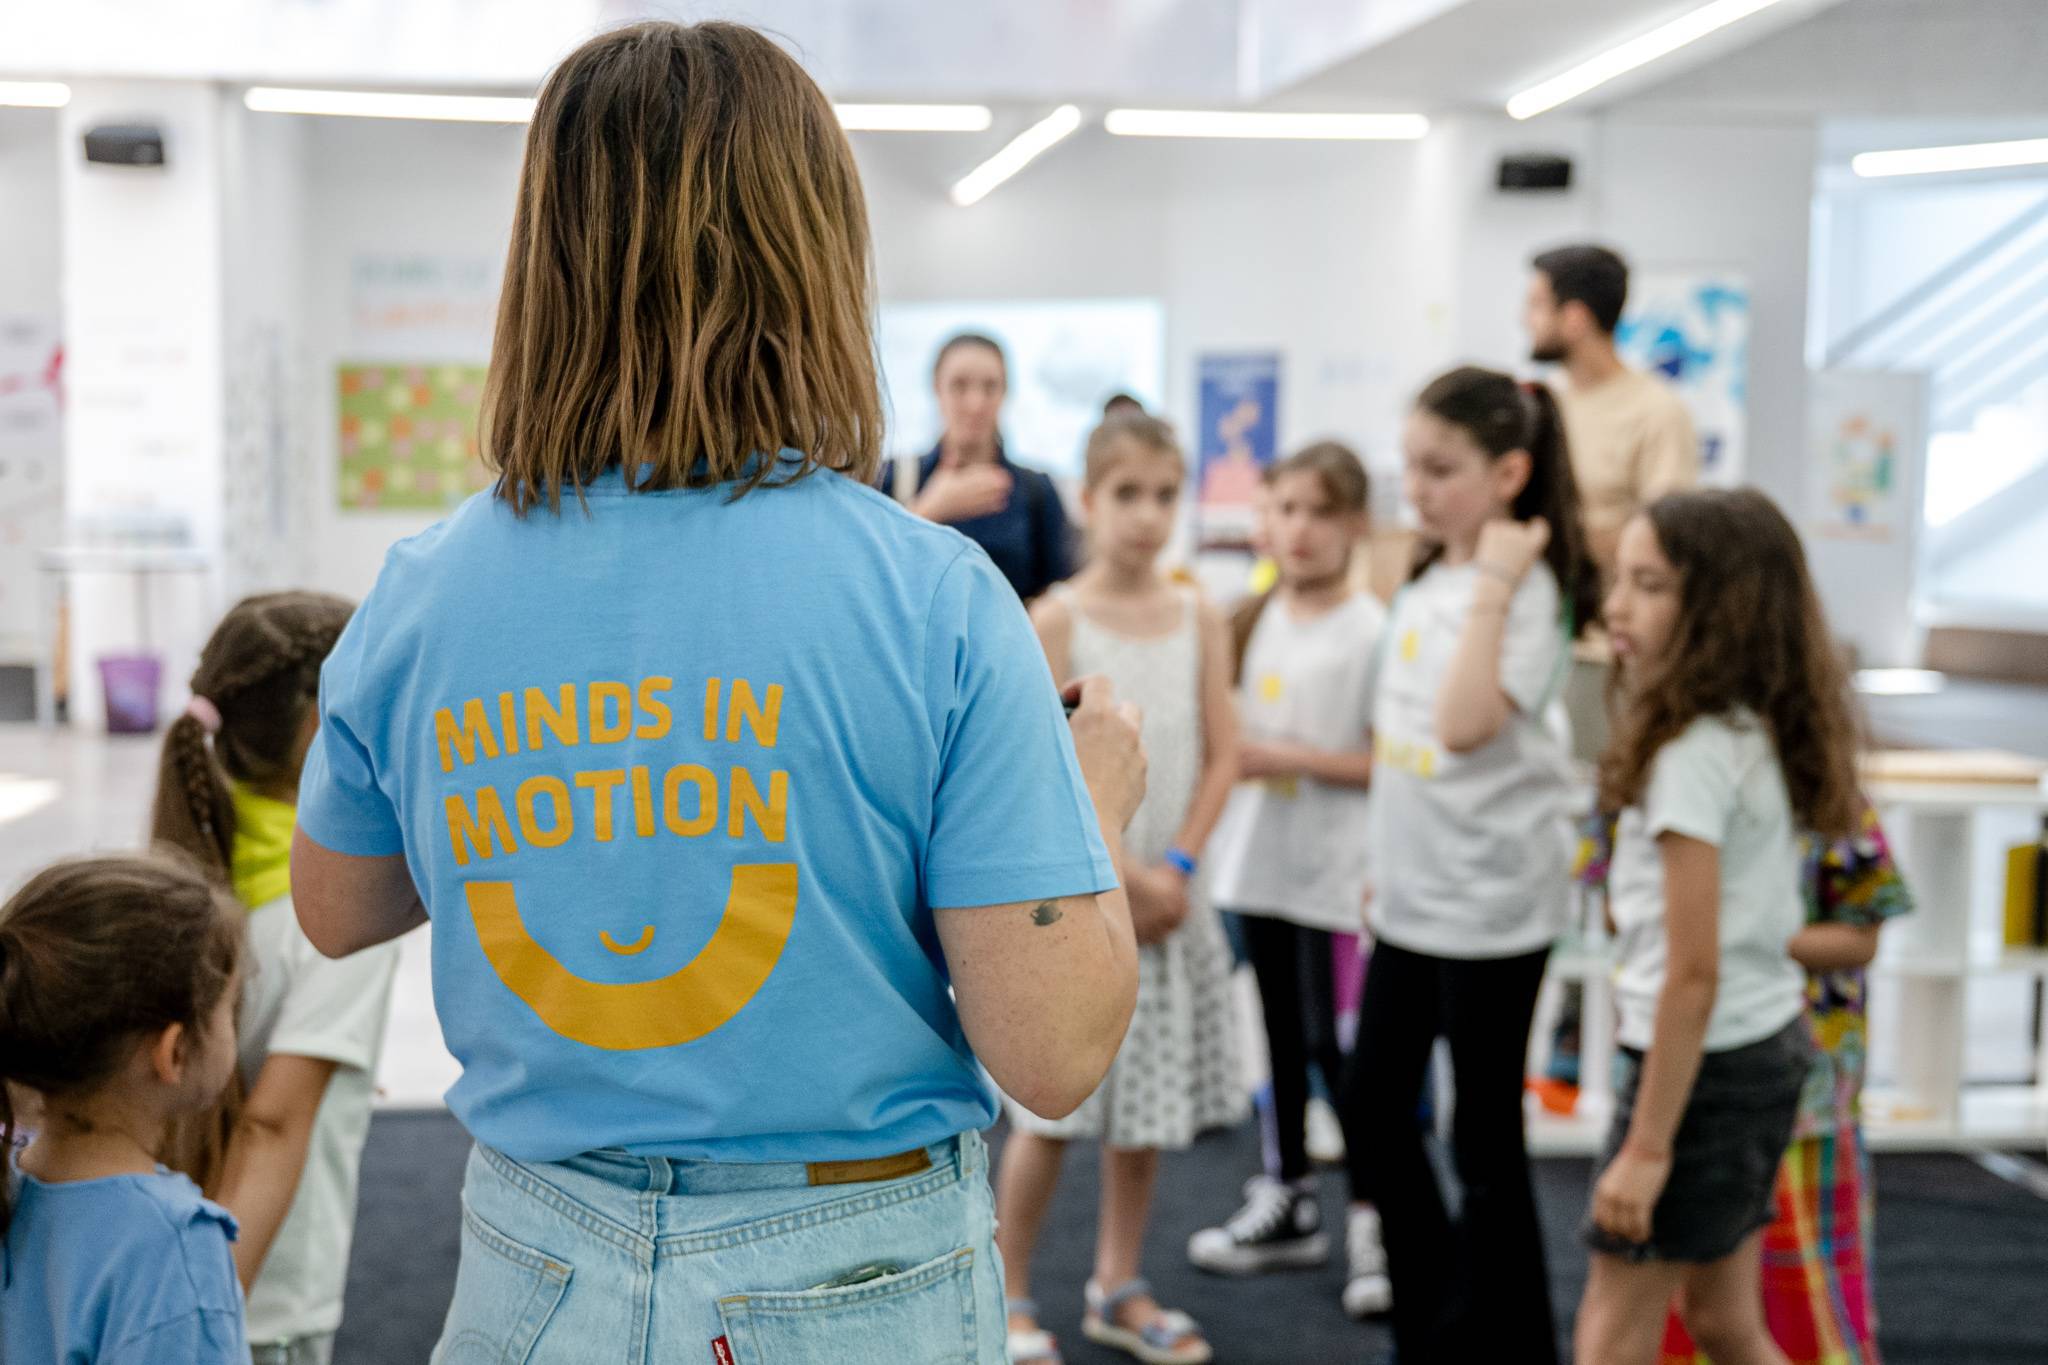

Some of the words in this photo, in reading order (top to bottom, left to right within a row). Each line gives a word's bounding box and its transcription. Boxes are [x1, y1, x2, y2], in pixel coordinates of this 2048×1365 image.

[434, 675, 674, 773] MINDS
[703, 676, 784, 748] IN
[444, 763, 789, 866] MOTION
